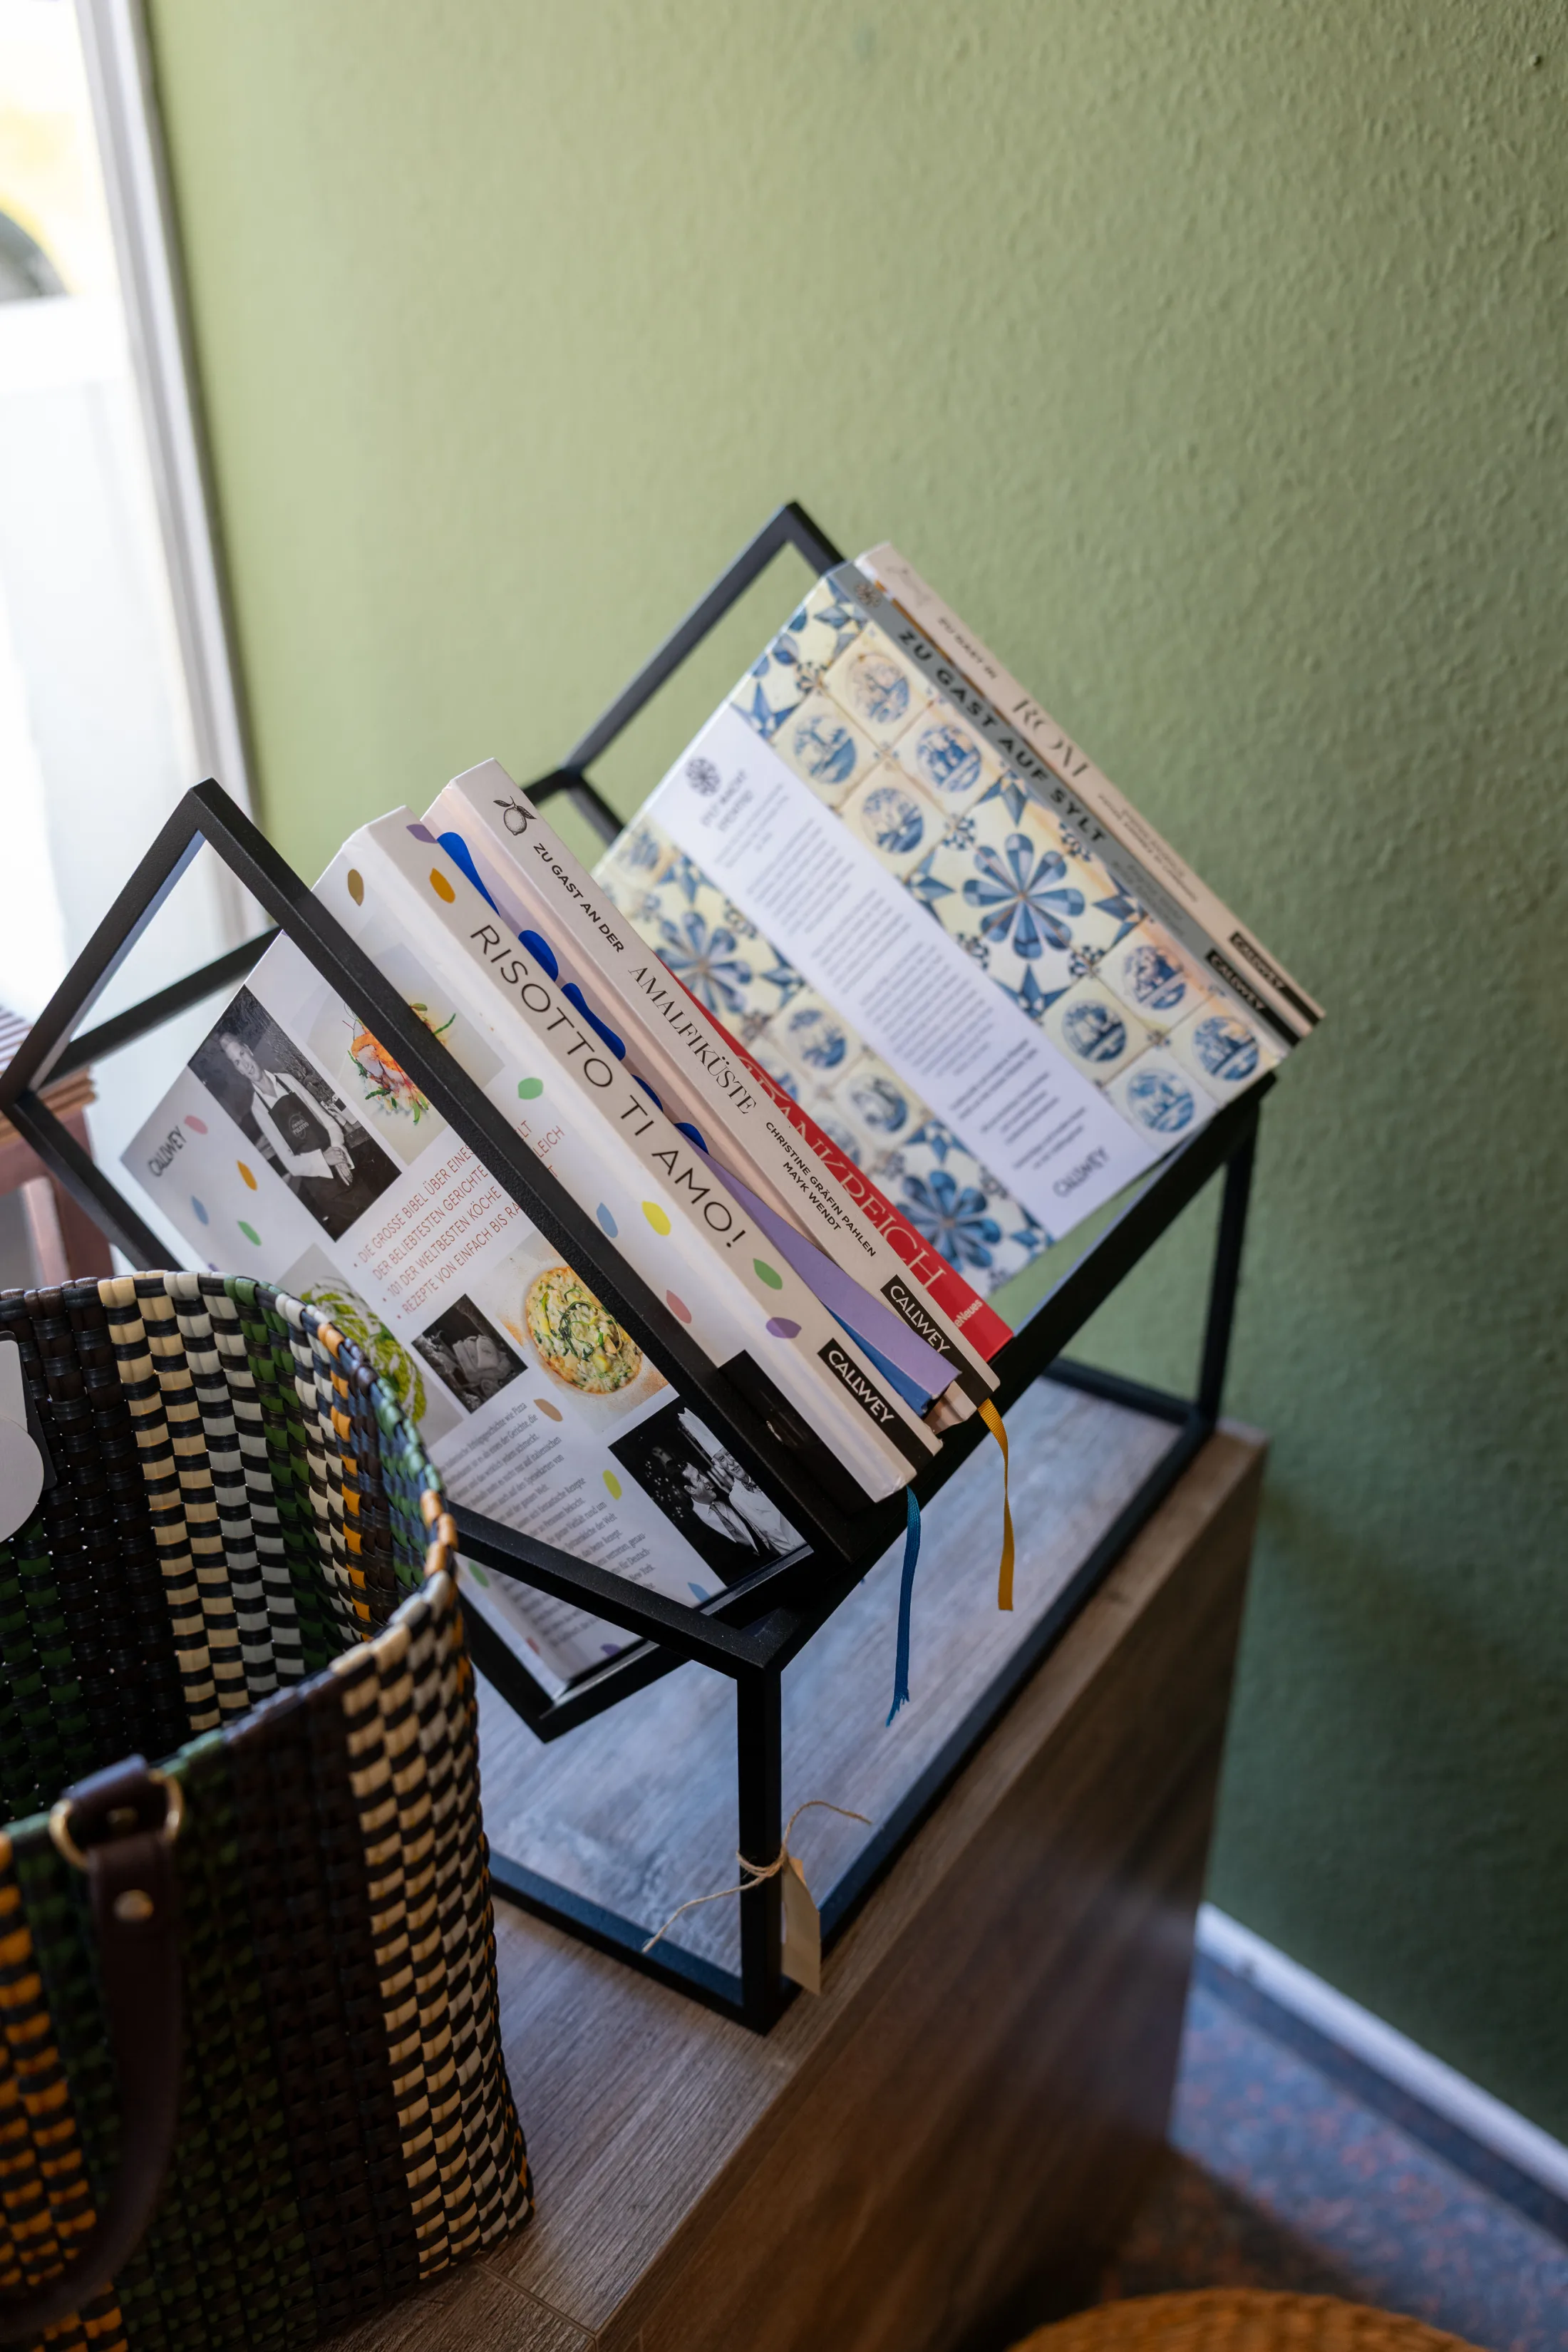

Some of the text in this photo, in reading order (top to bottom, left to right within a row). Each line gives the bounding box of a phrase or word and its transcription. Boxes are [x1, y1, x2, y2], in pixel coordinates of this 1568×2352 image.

[897, 629, 1107, 846] ZU GAST AUF SYLT
[532, 842, 625, 954] ZU GAST AN DER
[1208, 953, 1267, 1013] CALLWEY
[1230, 934, 1286, 991] CALLWEY
[626, 961, 759, 1116] AMALFIKÜSTE
[469, 922, 747, 1249] RISOTTO TI AMO!
[146, 1125, 189, 1178] CALLWEY
[358, 1244, 376, 1263] DIE
[371, 1213, 406, 1249] GROSSE
[401, 1191, 428, 1219] BIBEL
[422, 1167, 450, 1195] ÜBER
[387, 1280, 403, 1298] 101
[399, 1264, 420, 1286] DER
[415, 1215, 470, 1269] WELTBESTEN
[465, 1185, 502, 1221] KÖCHE
[532, 1125, 565, 1157] LEICH
[763, 1120, 877, 1258] CHRISTINE GRÄFIN PAHLEN
[781, 1162, 842, 1232] MAYK WENDT
[372, 1259, 393, 1280] DER
[388, 1207, 446, 1264] BELIEBTESTEN
[442, 1165, 488, 1212] GERICHTE
[401, 1213, 508, 1314] REZEPTE VON EINFACH BIS
[887, 1283, 950, 1356] CALLWEY
[951, 1298, 984, 1329] eNeues
[504, 1411, 515, 1423] wie
[511, 1400, 527, 1416] Pizza
[825, 1348, 894, 1426] CALLWEY
[500, 1433, 511, 1445] der
[507, 1418, 532, 1440] Gerichte,
[527, 1412, 539, 1424] die
[514, 1430, 540, 1454] schmeckt.
[530, 1433, 562, 1462] italienischen
[552, 1453, 564, 1465] von
[564, 1475, 587, 1497] Rezepte
[583, 1505, 598, 1520] rund
[596, 1500, 607, 1511] um
[594, 1519, 606, 1531] der
[602, 1510, 618, 1526] Welt
[602, 1526, 624, 1547] Rezept.
[605, 1539, 632, 1564] vertreten,
[626, 1544, 652, 1567] Deutsch-
